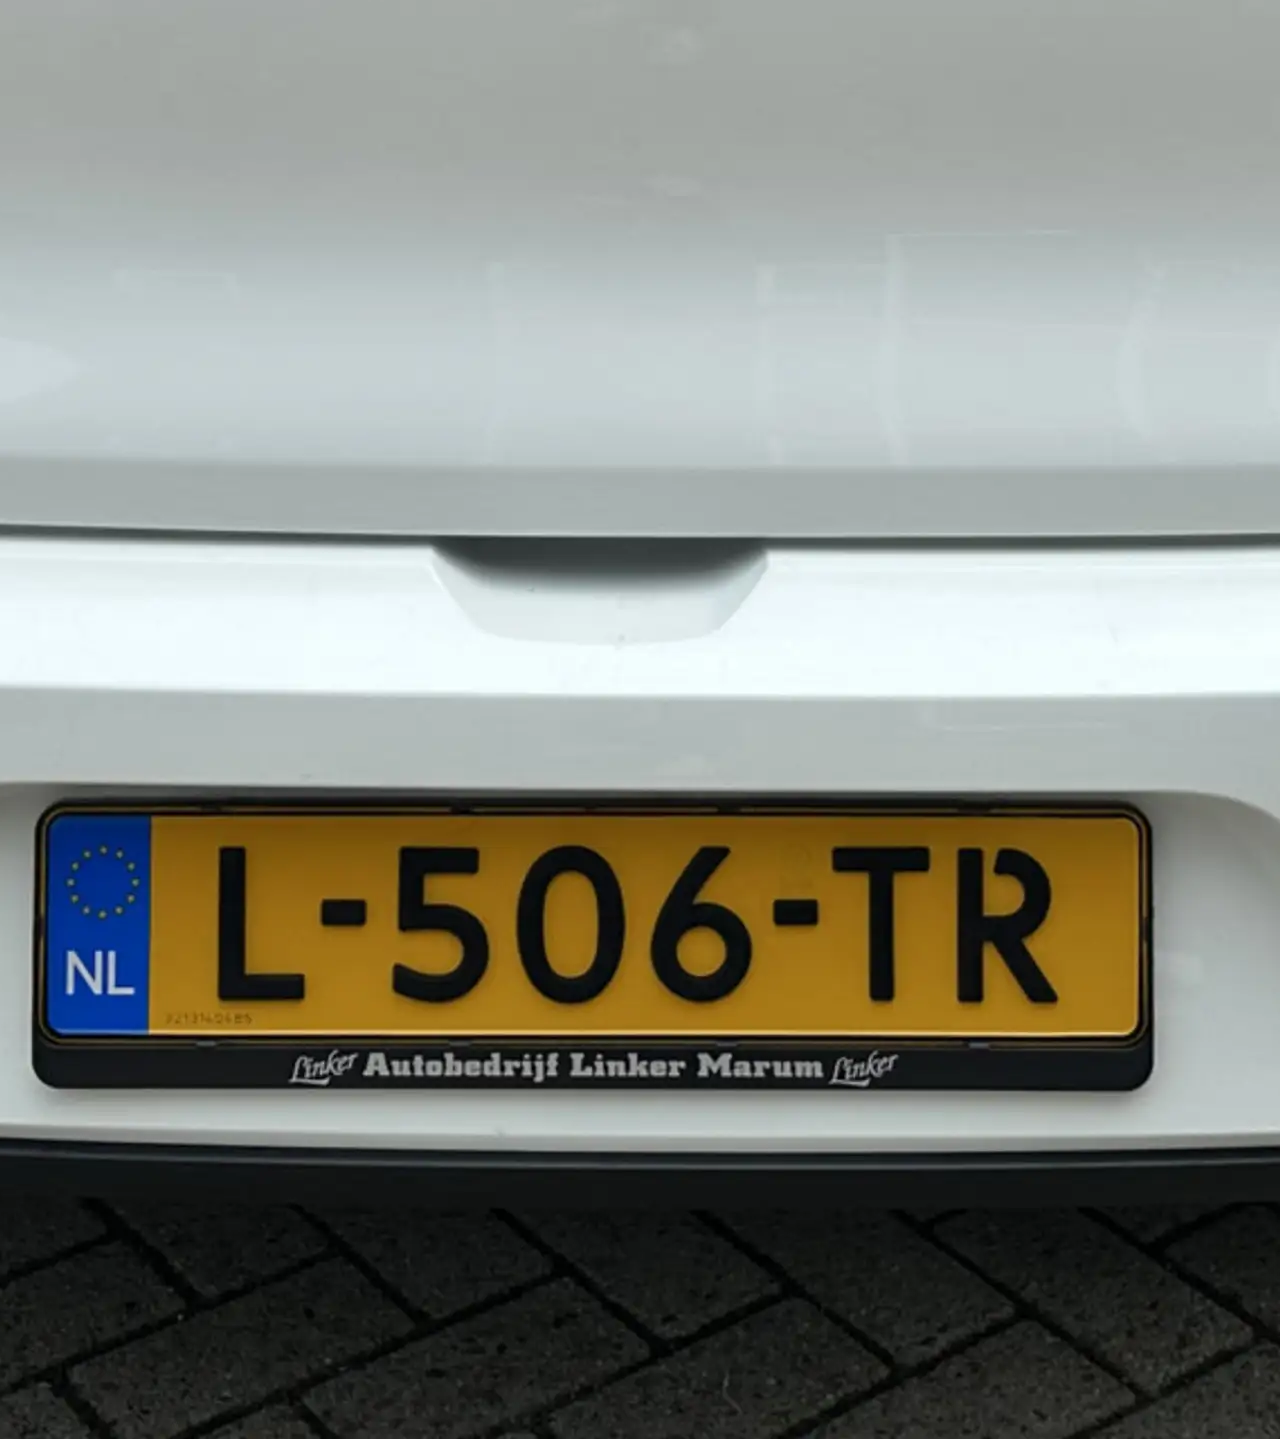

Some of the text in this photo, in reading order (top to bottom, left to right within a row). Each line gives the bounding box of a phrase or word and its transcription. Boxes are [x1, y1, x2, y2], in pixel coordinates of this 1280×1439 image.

[217, 845, 1058, 1004] L-506-TR
[66, 951, 135, 996] NL
[289, 1049, 899, 1087] Linker Autobedrijf Linker Marum Linker
